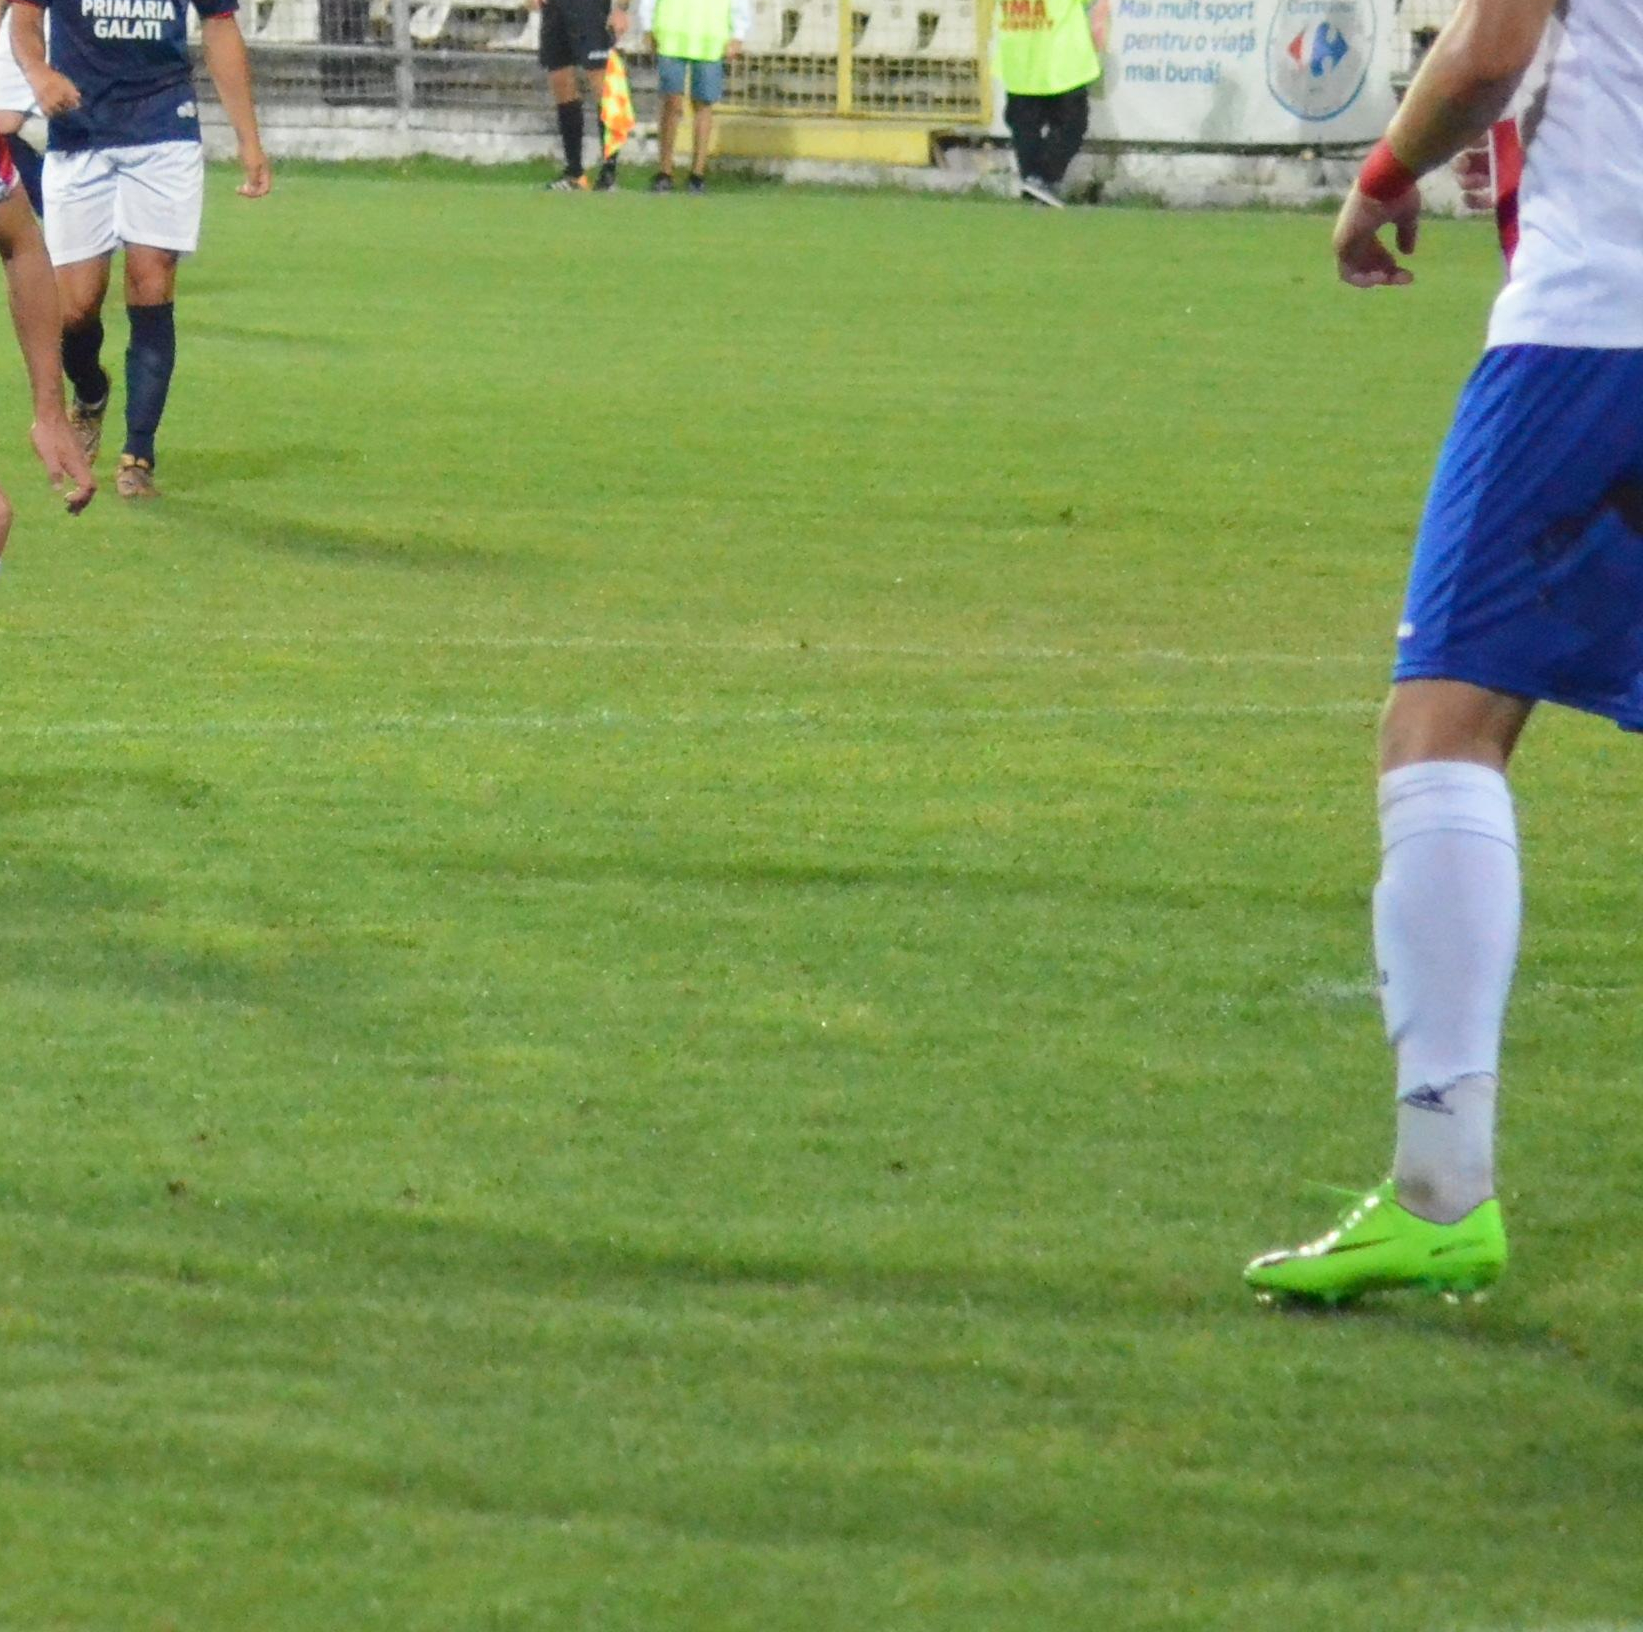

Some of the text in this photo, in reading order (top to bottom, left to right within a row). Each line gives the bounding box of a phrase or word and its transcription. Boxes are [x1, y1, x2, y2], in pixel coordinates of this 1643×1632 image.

[1204, 0, 1254, 25] sport
[93, 19, 162, 40] GALATI
[1123, 30, 1192, 56] pentru
[1195, 35, 1207, 52] o
[1125, 58, 1161, 82] mai
